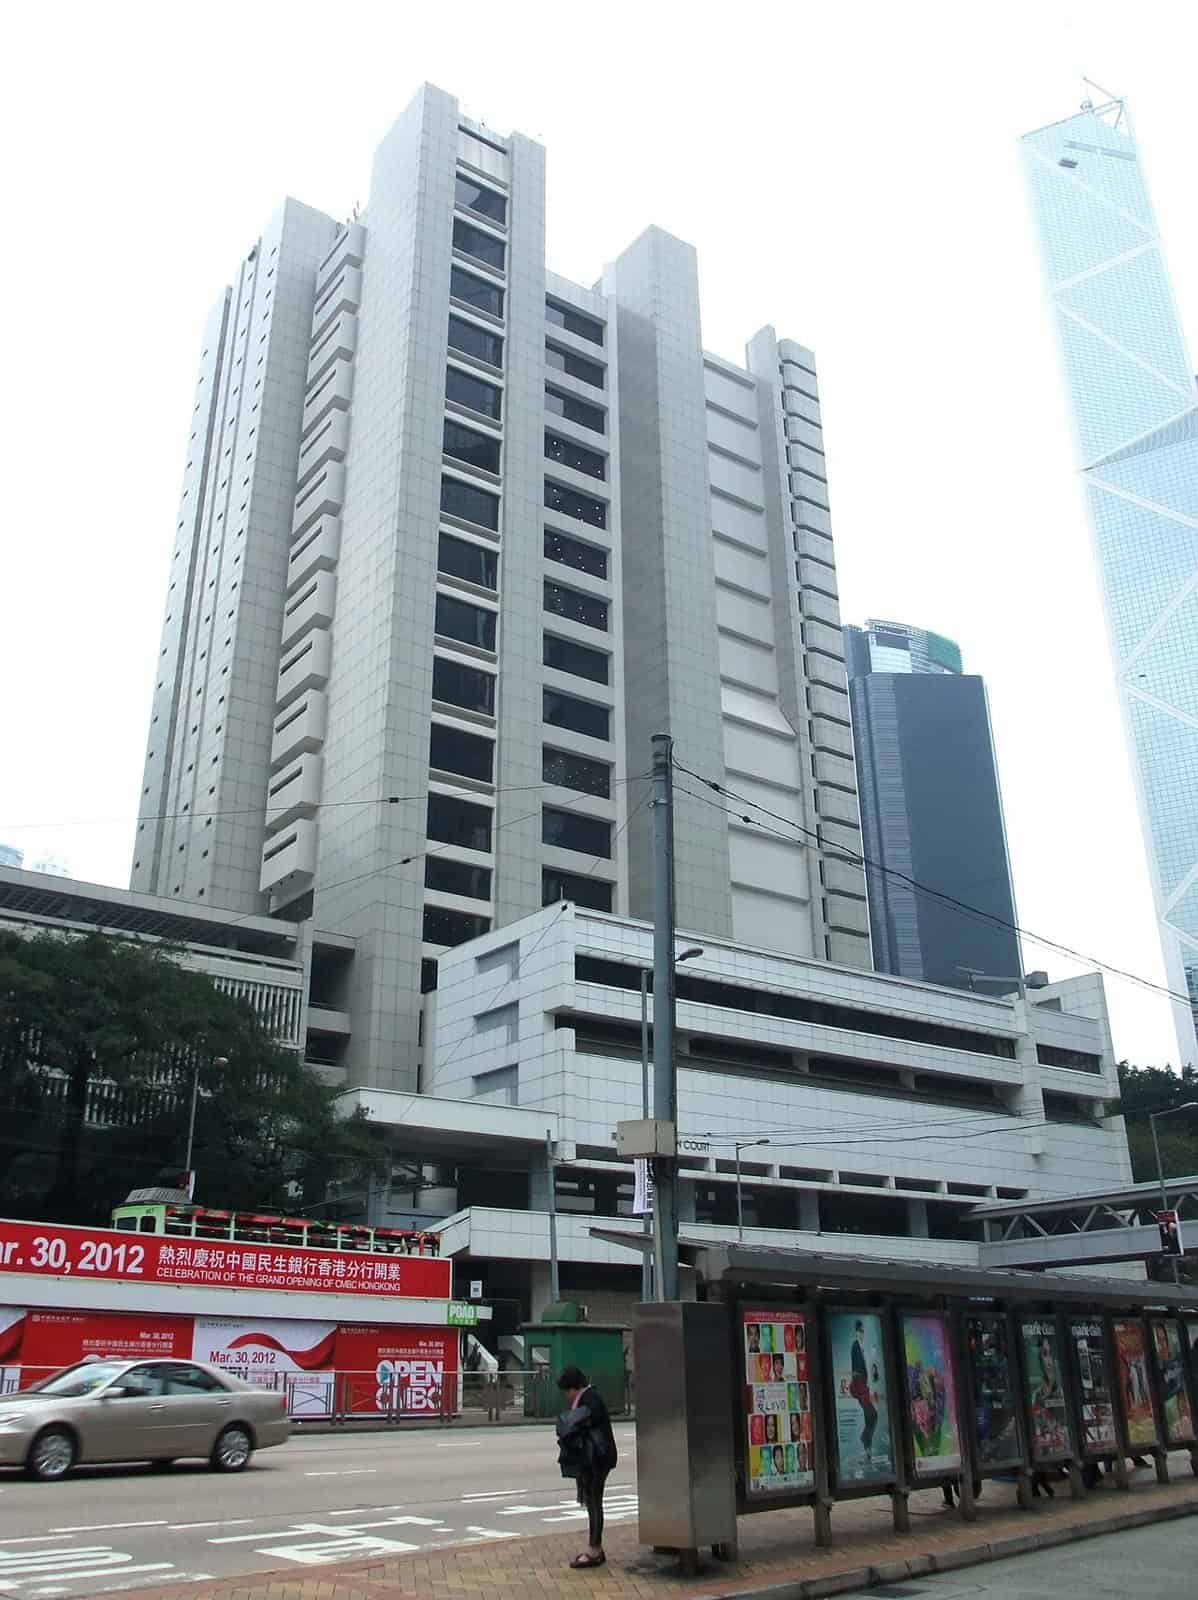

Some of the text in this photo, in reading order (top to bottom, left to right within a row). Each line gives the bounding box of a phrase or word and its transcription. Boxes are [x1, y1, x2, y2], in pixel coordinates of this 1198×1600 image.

[30, 1236, 72, 1274] 30,
[77, 1241, 145, 1273] 2012
[158, 1245, 401, 1281] 熱烈慶祝中國民生銀行香港分行開業
[156, 1267, 401, 1292] CELEBRATION OF THE GRAND OPENING OF CMBC HONGKONG
[209, 1351, 276, 1365] Mar. 30, 2012
[376, 1360, 443, 1387] OPEN
